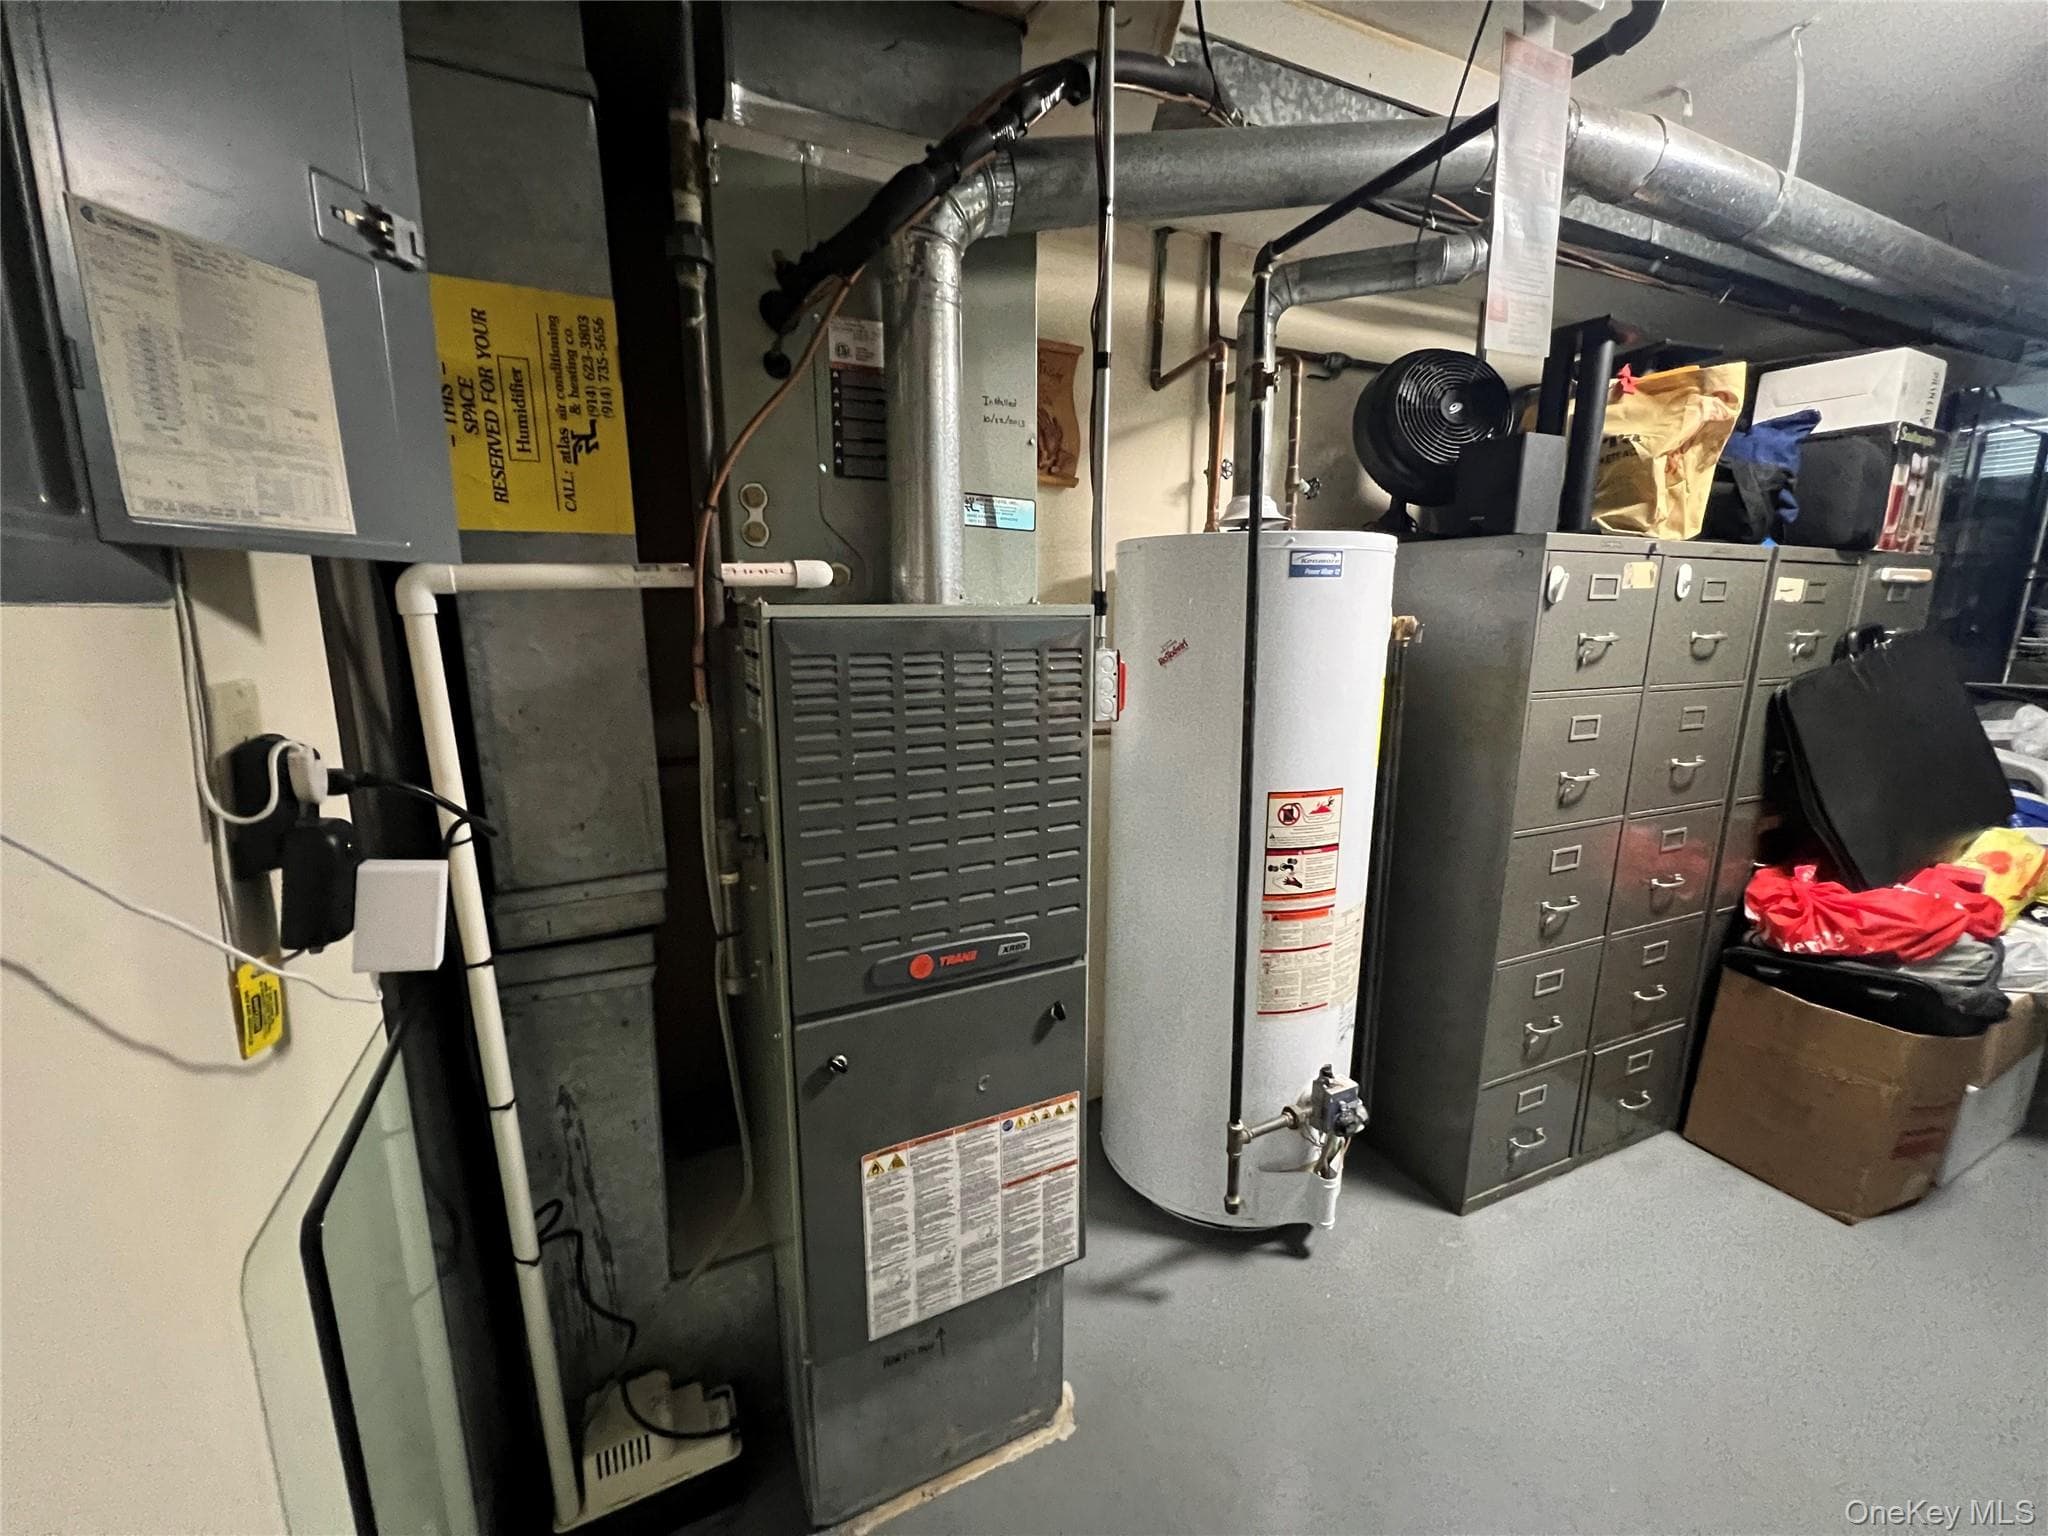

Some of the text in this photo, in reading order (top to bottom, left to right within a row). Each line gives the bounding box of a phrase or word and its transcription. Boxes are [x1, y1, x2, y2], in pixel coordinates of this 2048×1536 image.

[457, 375, 480, 436] SPACE
[471, 307, 510, 504] RESERVED FOR YOUR
[509, 366, 532, 454] Humidifier
[566, 348, 579, 399] heating
[569, 404, 582, 416] &
[577, 314, 599, 418] (914) 623-3803
[592, 317, 614, 419] (914) 735-5656
[547, 314, 578, 513] CALL: atlas air conditioning
[940, 951, 977, 966] TRANE
